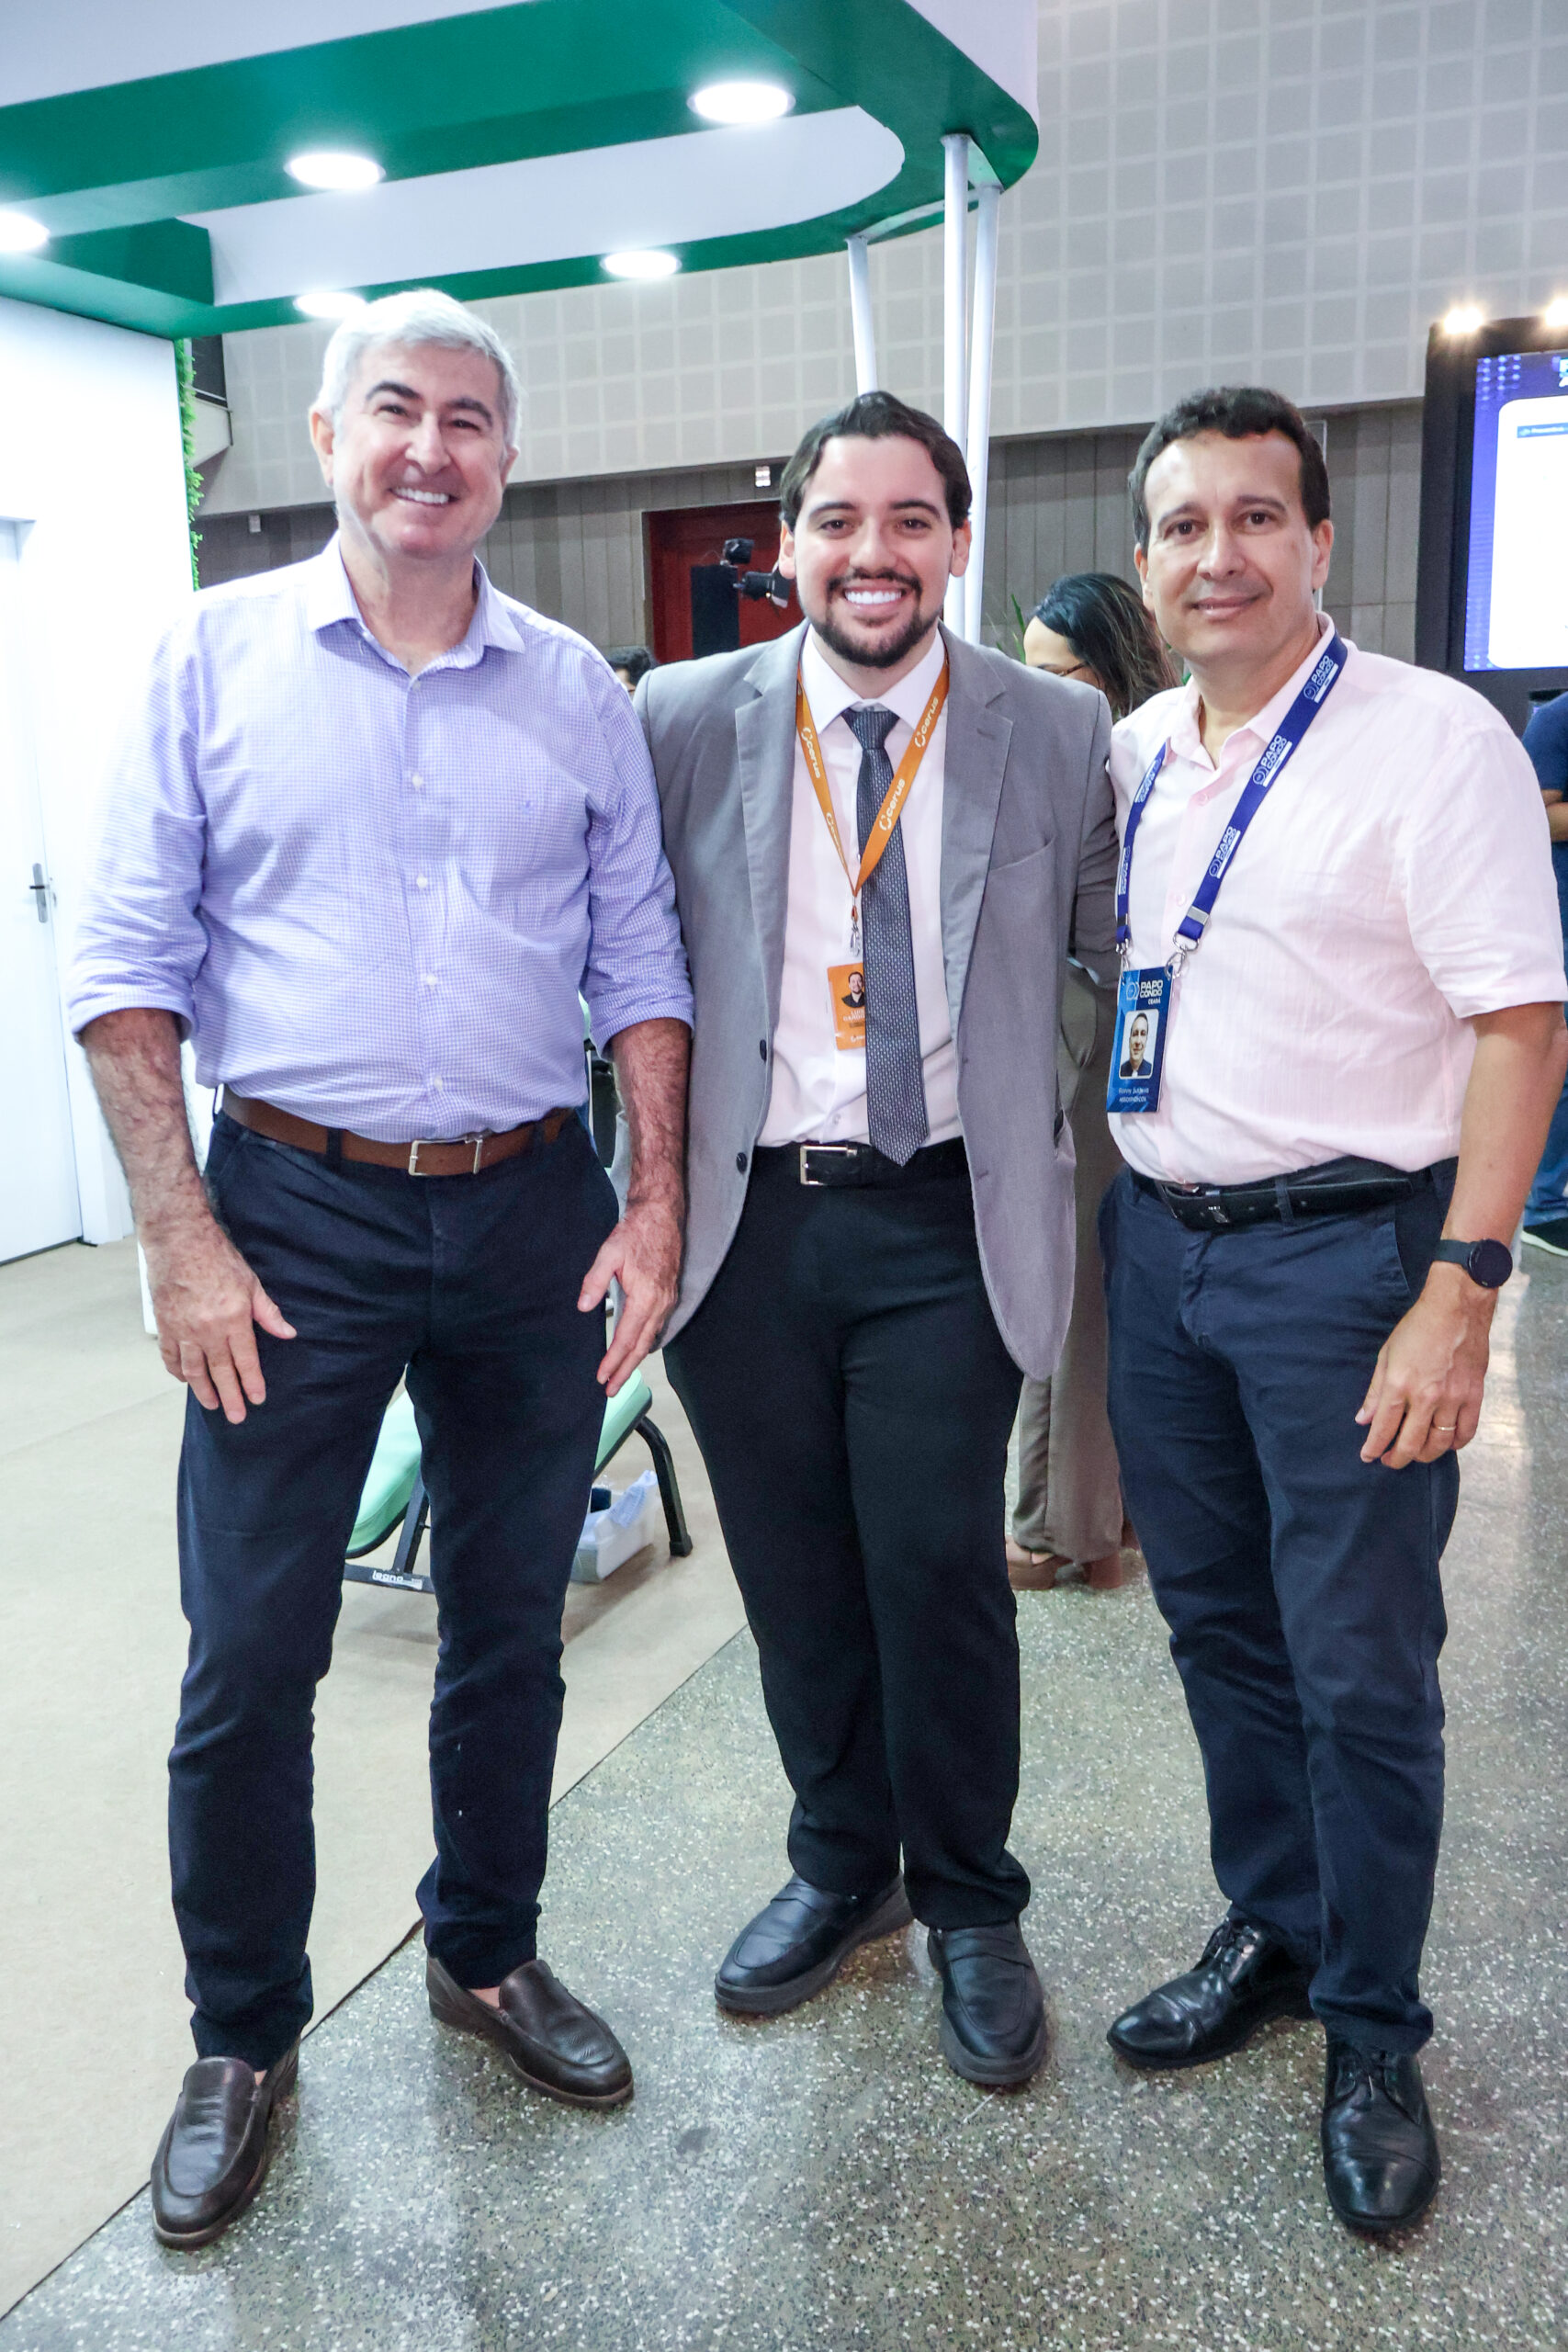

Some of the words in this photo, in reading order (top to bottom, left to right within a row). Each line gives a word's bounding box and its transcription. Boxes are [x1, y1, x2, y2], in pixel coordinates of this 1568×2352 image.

[1312, 655, 1330, 684] PAPO
[920, 697, 939, 734] cerus
[807, 741, 821, 779] cerus
[1260, 735, 1282, 766] PAPO
[886, 778, 906, 818] cerus
[1215, 826, 1233, 858] PAPO
[1139, 989, 1163, 999] CONDO
[1140, 979, 1164, 991] PAPO
